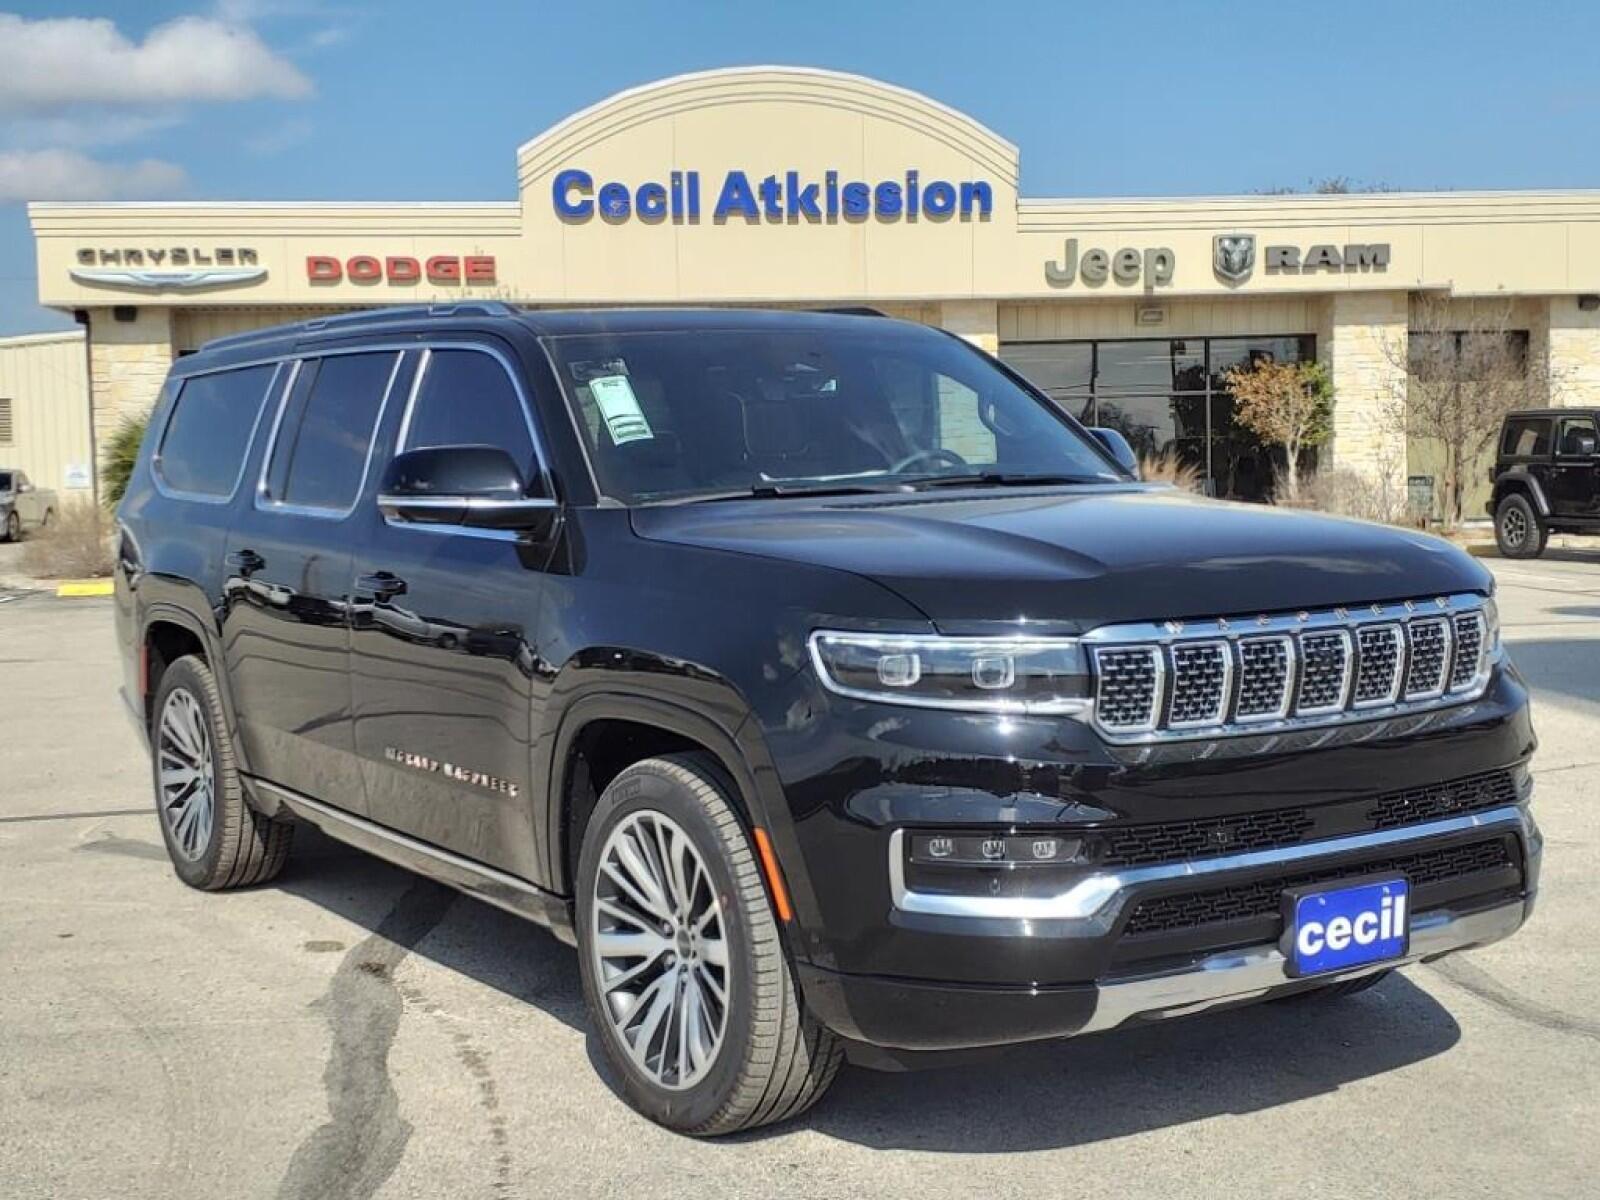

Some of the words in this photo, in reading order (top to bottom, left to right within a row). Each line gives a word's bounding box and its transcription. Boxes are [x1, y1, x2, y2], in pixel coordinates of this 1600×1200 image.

[551, 168, 700, 225] Cecil
[712, 168, 994, 225] Atkission
[77, 247, 259, 266] CHRYSLER
[305, 254, 497, 287] DODGE
[1044, 238, 1176, 295] Jeep
[1264, 243, 1392, 276] RAM
[1297, 894, 1406, 956] cecil
